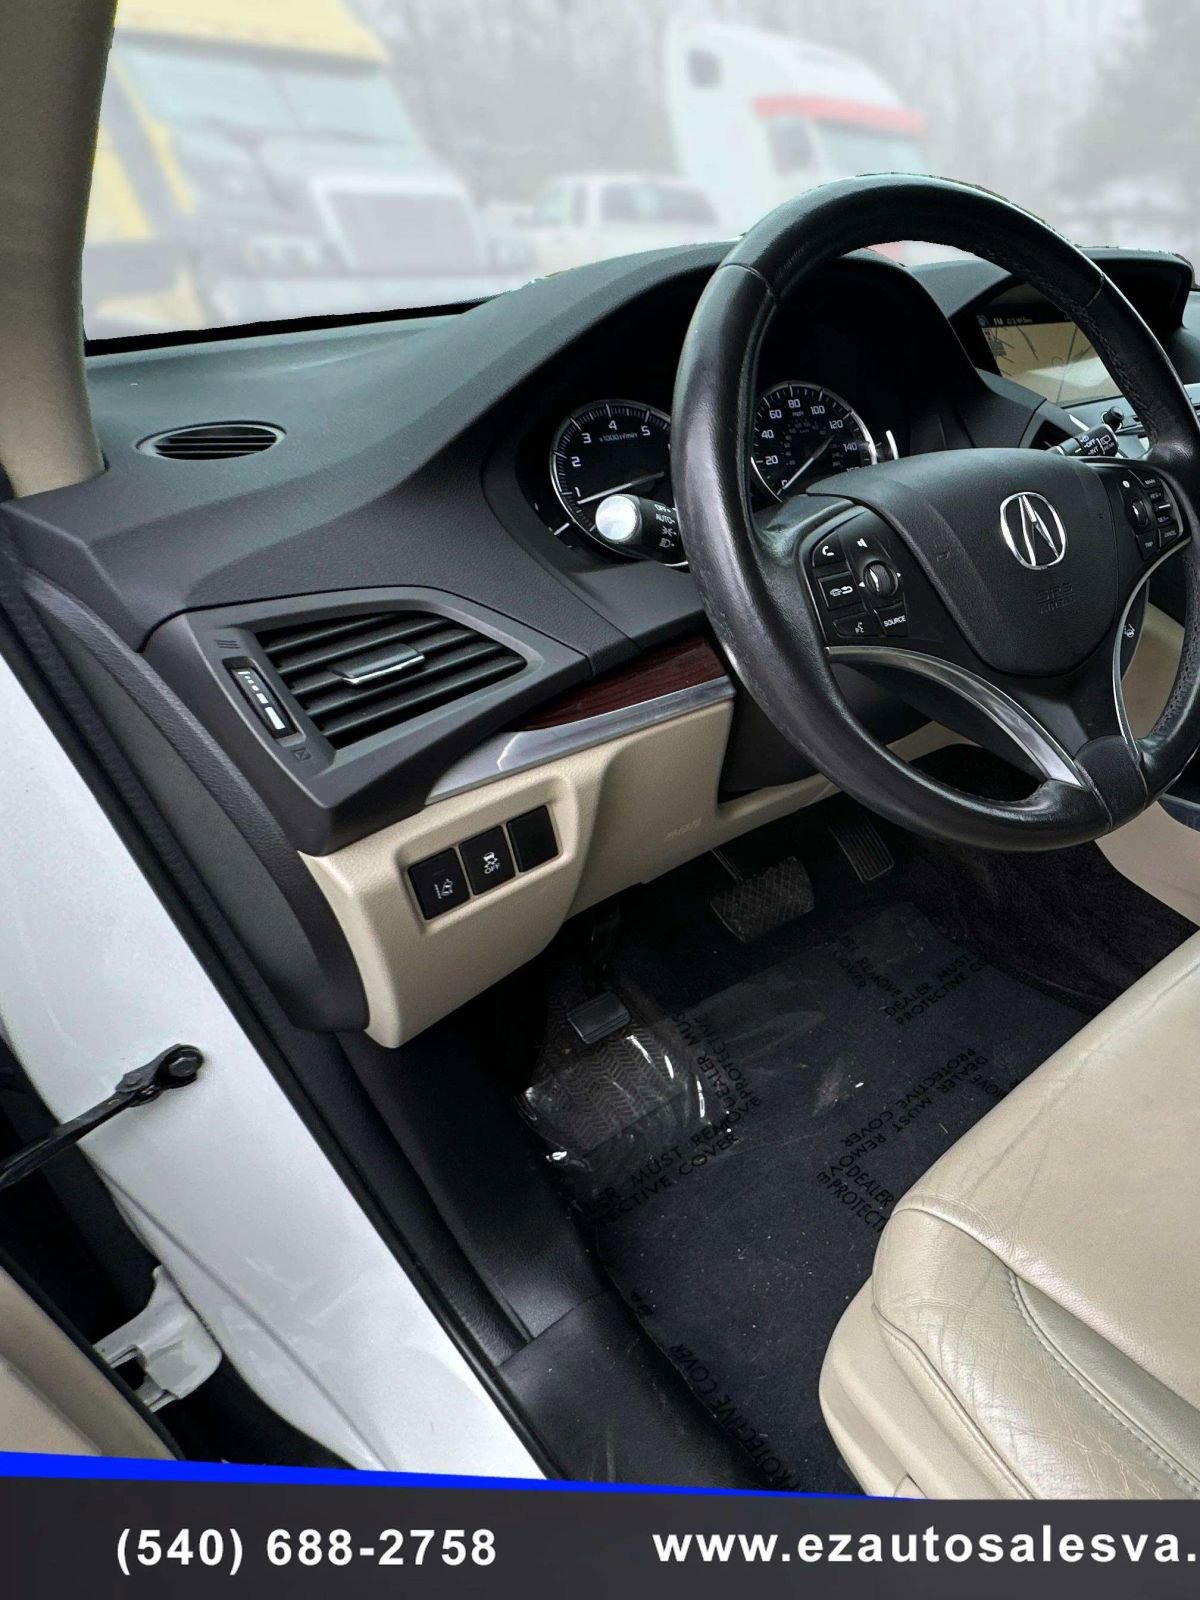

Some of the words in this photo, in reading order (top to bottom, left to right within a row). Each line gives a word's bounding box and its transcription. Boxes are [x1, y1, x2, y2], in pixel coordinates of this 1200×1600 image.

[788, 398, 800, 408] 80
[769, 409, 782, 419] 60
[810, 405, 826, 415] 100
[608, 419, 618, 431] 4
[640, 425, 652, 437] 5
[829, 420, 844, 430] 120
[581, 432, 592, 444] 3
[761, 429, 774, 439] 40
[843, 442, 858, 453] 140
[570, 456, 582, 468] 2
[765, 455, 779, 466] 20
[573, 485, 581, 498] 1
[884, 615, 907, 628] SOURCE
[891, 1096, 933, 1132] MUST
[841, 1110, 894, 1147] COVER
[678, 1132, 740, 1177] COVER
[631, 1146, 683, 1187] MUST
[845, 1165, 895, 1208] DEALER
